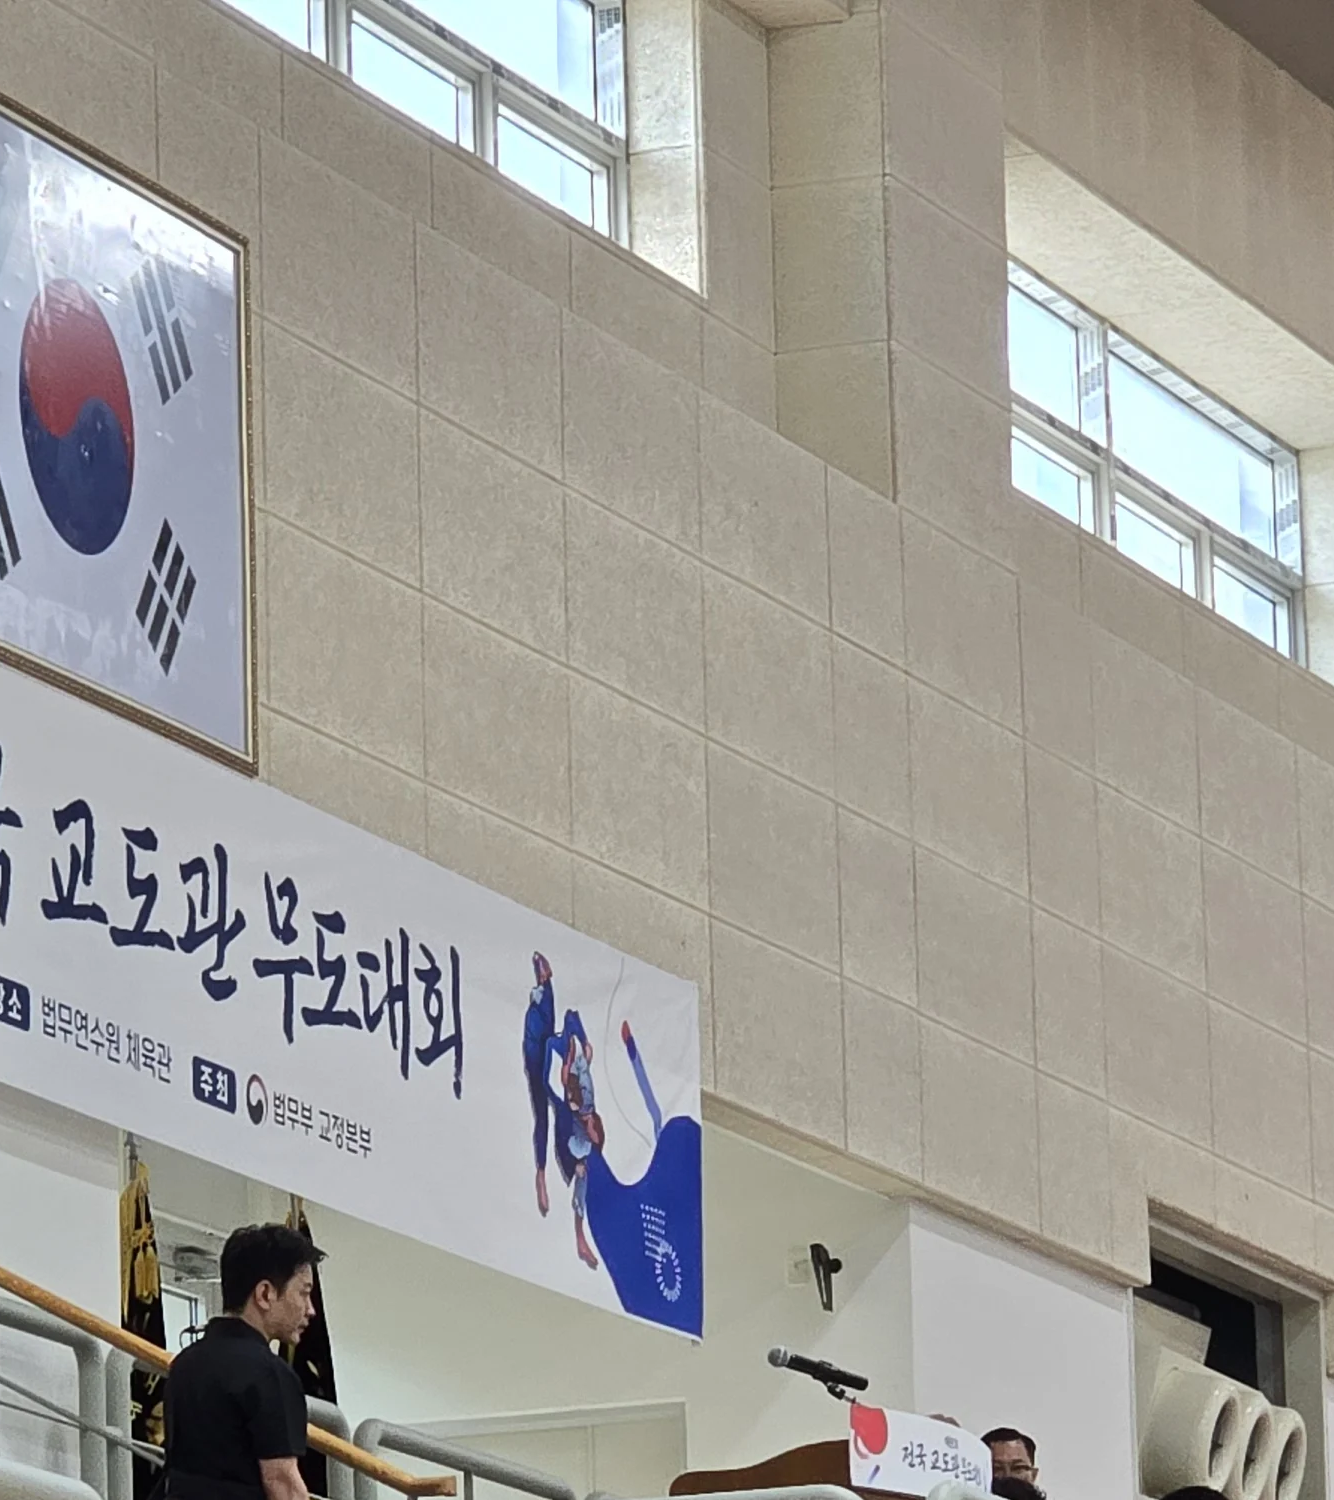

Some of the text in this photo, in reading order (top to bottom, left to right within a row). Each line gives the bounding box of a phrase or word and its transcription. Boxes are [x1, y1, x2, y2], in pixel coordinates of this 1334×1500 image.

[40, 798, 246, 1001] 교도관
[253, 871, 463, 1100] 무도대회
[41, 995, 120, 1063] 법무연수원
[126, 1029, 172, 1083] 체육관
[200, 1065, 372, 1158] 주최 법무부 교정본부
[902, 1441, 927, 1472] 전국
